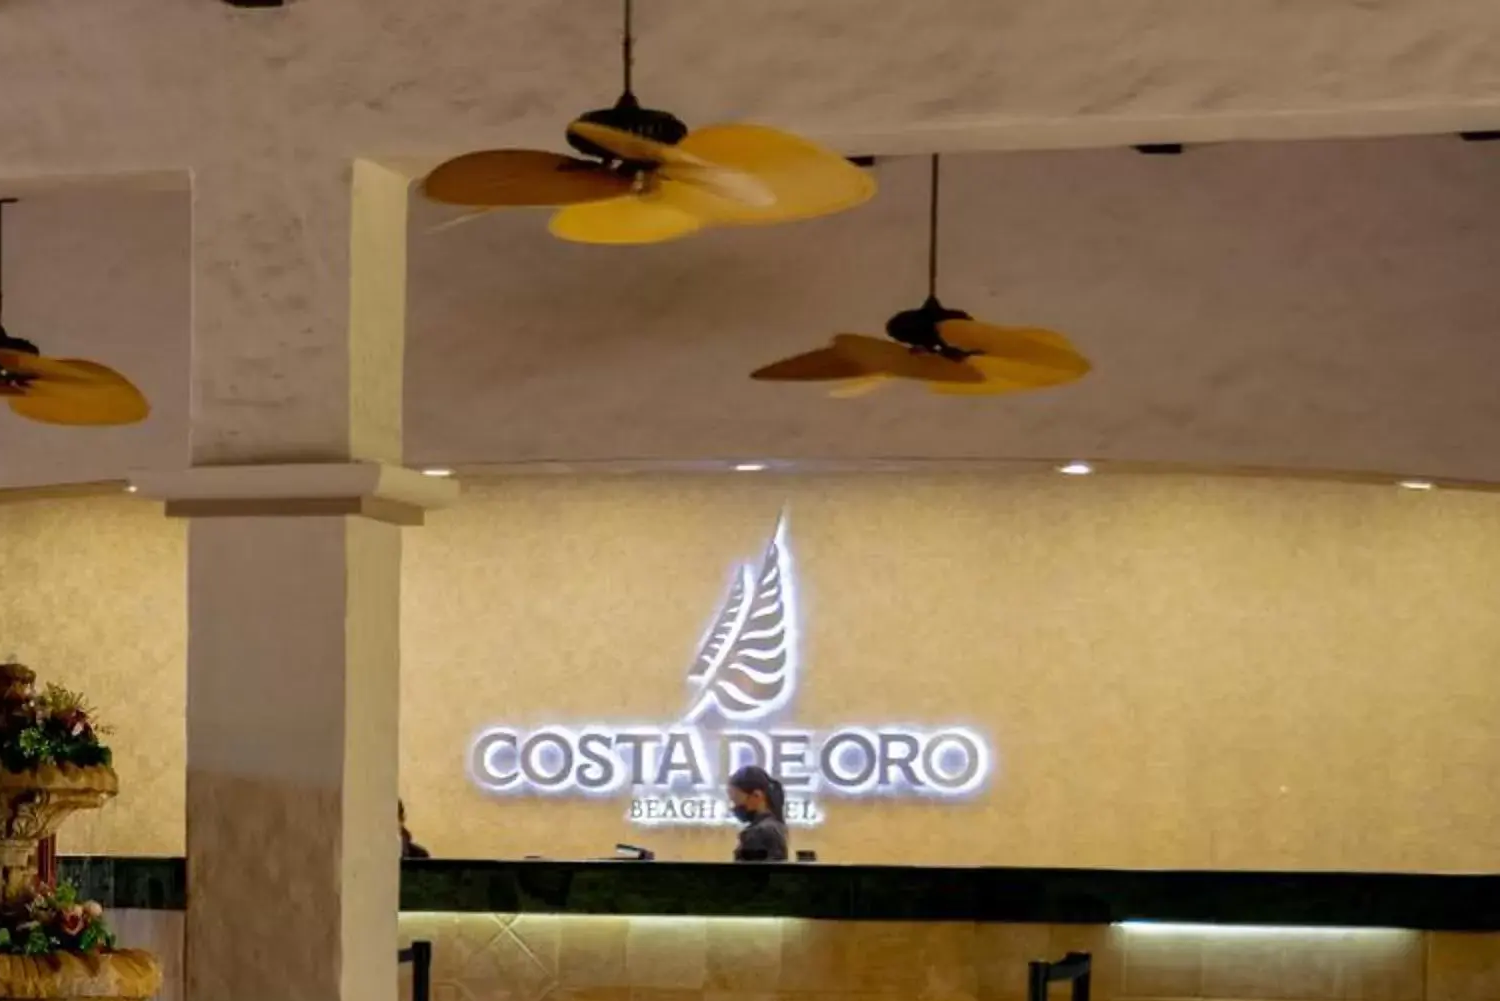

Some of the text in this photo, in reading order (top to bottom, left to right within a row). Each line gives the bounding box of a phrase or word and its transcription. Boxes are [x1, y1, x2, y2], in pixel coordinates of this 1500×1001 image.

[472, 732, 980, 788] COSTA DE ORO
[630, 799, 717, 819] BEACH
